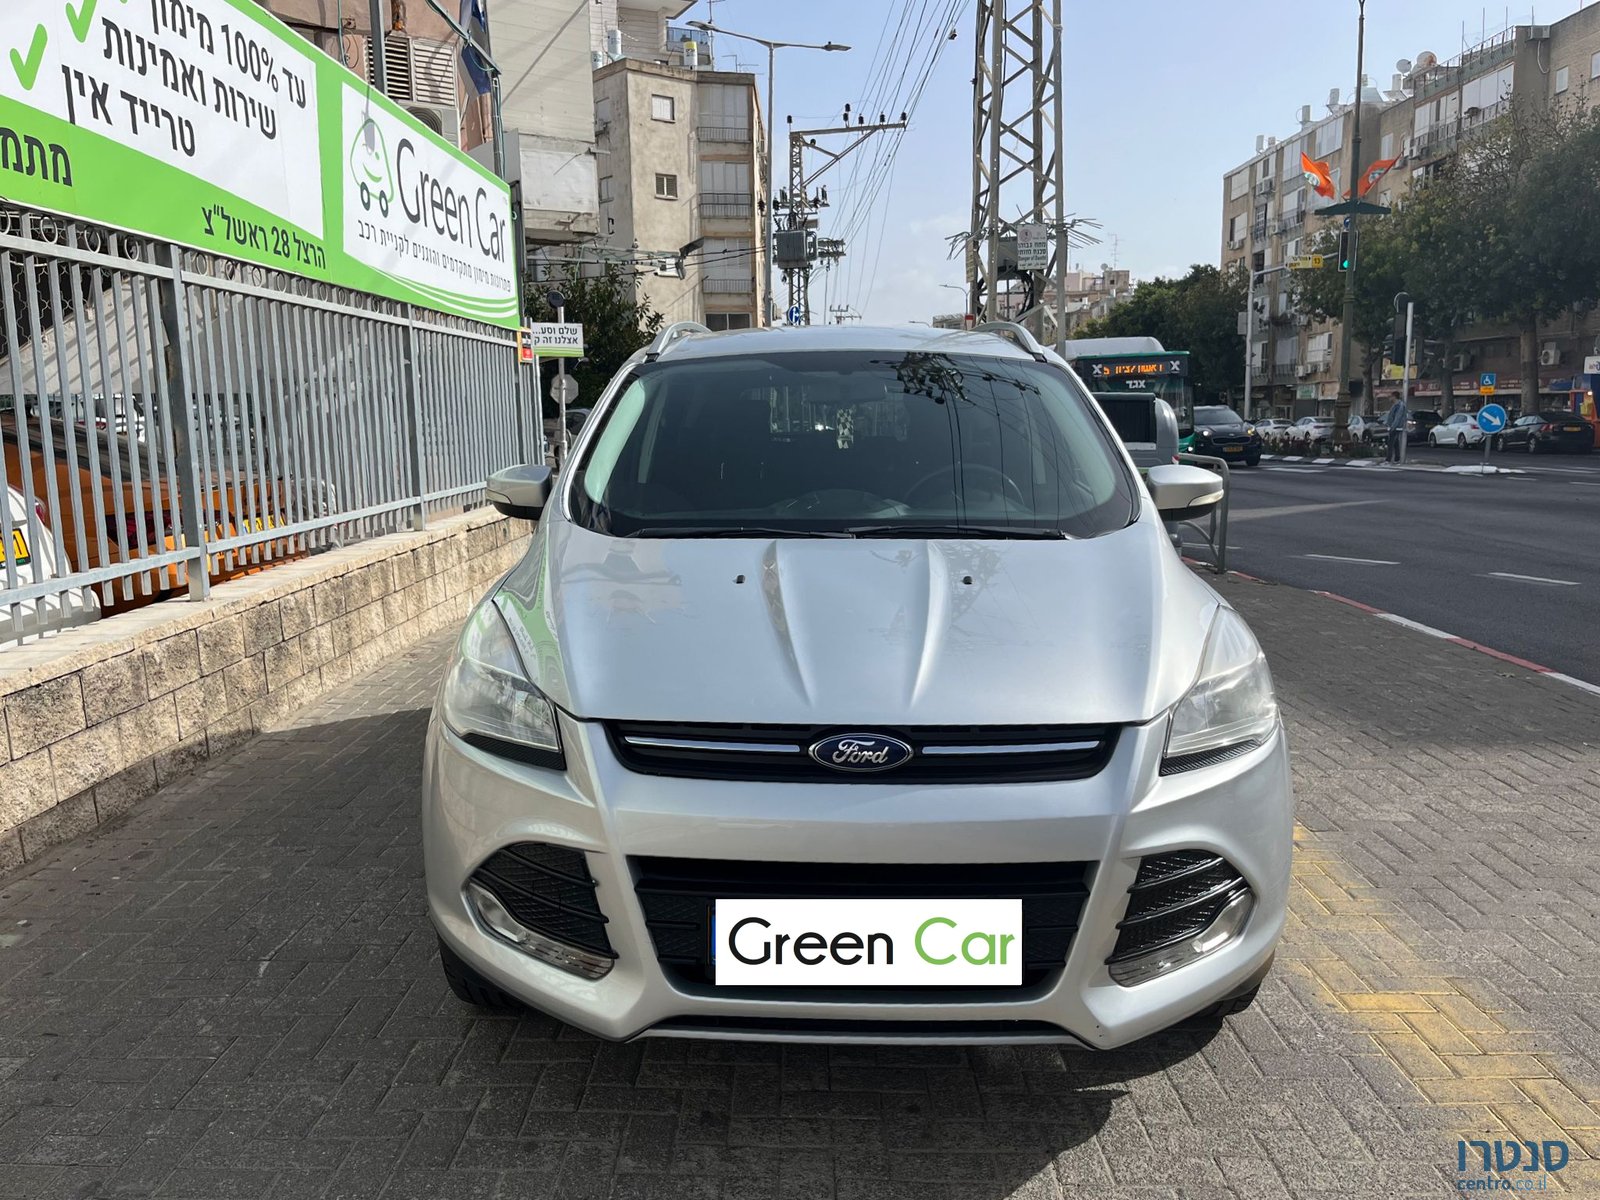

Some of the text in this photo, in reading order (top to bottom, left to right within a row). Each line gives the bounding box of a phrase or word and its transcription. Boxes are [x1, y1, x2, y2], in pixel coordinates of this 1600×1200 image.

[151, 0, 306, 109] עד 100% מימון
[101, 16, 276, 140] שירות ואמינות
[61, 64, 196, 157] טרייד אין
[396, 138, 505, 263] Green Car
[271, 226, 291, 258] 28
[358, 219, 377, 243] רכב
[380, 228, 410, 258] לקניית
[292, 231, 326, 270] הרצל
[412, 242, 440, 266] והוגנים
[442, 254, 472, 279] מתקדמים
[542, 336, 552, 344] זה
[554, 336, 578, 344] אצלנו
[558, 326, 578, 335] שלם
[1125, 379, 1146, 389] אגד
[832, 739, 889, 763] Ford
